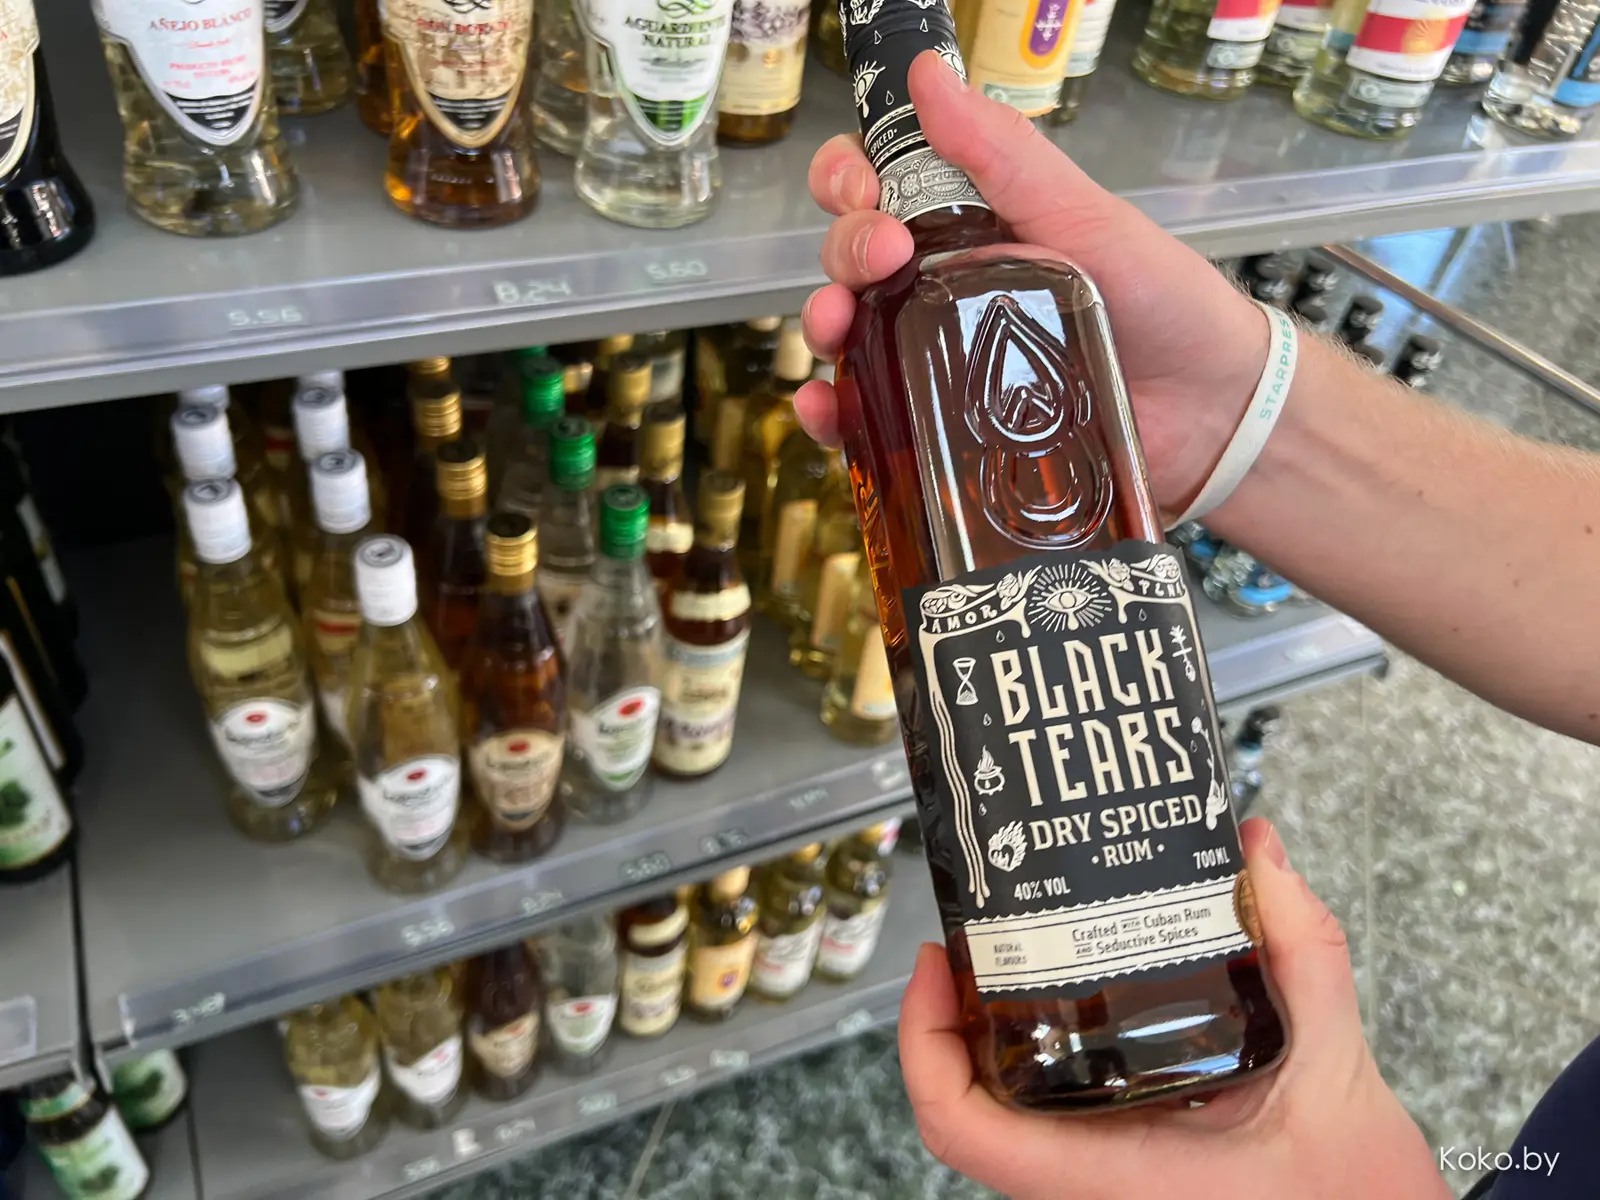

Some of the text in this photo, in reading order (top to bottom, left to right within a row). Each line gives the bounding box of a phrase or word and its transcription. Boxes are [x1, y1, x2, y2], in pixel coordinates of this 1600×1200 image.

[1259, 311, 1293, 421] STARPRES
[930, 604, 998, 633] AMOR
[989, 627, 1176, 727] BLACK
[1008, 706, 1195, 807] TEARS
[1028, 794, 1204, 851] DRY SPICED
[1013, 876, 1071, 901] 40% VOL
[1071, 923, 1118, 943] Crafted
[1143, 911, 1182, 929] Cuban
[1184, 907, 1212, 921] Rum
[1096, 933, 1156, 955] Seductive
[1158, 925, 1199, 945] Spices
